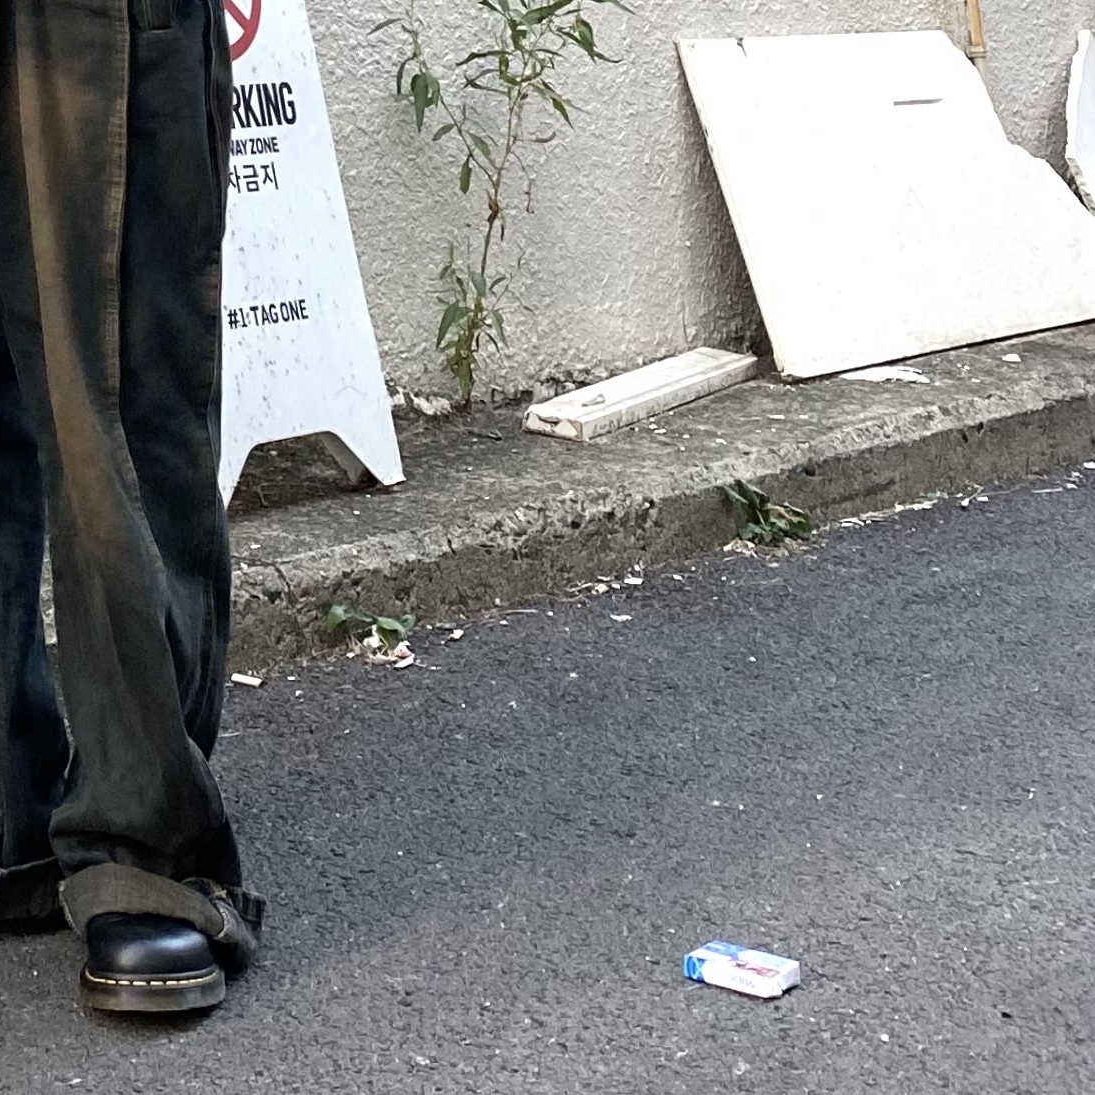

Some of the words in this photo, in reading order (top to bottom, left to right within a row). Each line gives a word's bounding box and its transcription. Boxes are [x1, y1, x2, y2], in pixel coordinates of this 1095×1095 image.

[232, 81, 297, 129] RKING
[248, 136, 280, 155] ZONE
[228, 161, 279, 194] 차금지
[279, 299, 309, 323] ONE
